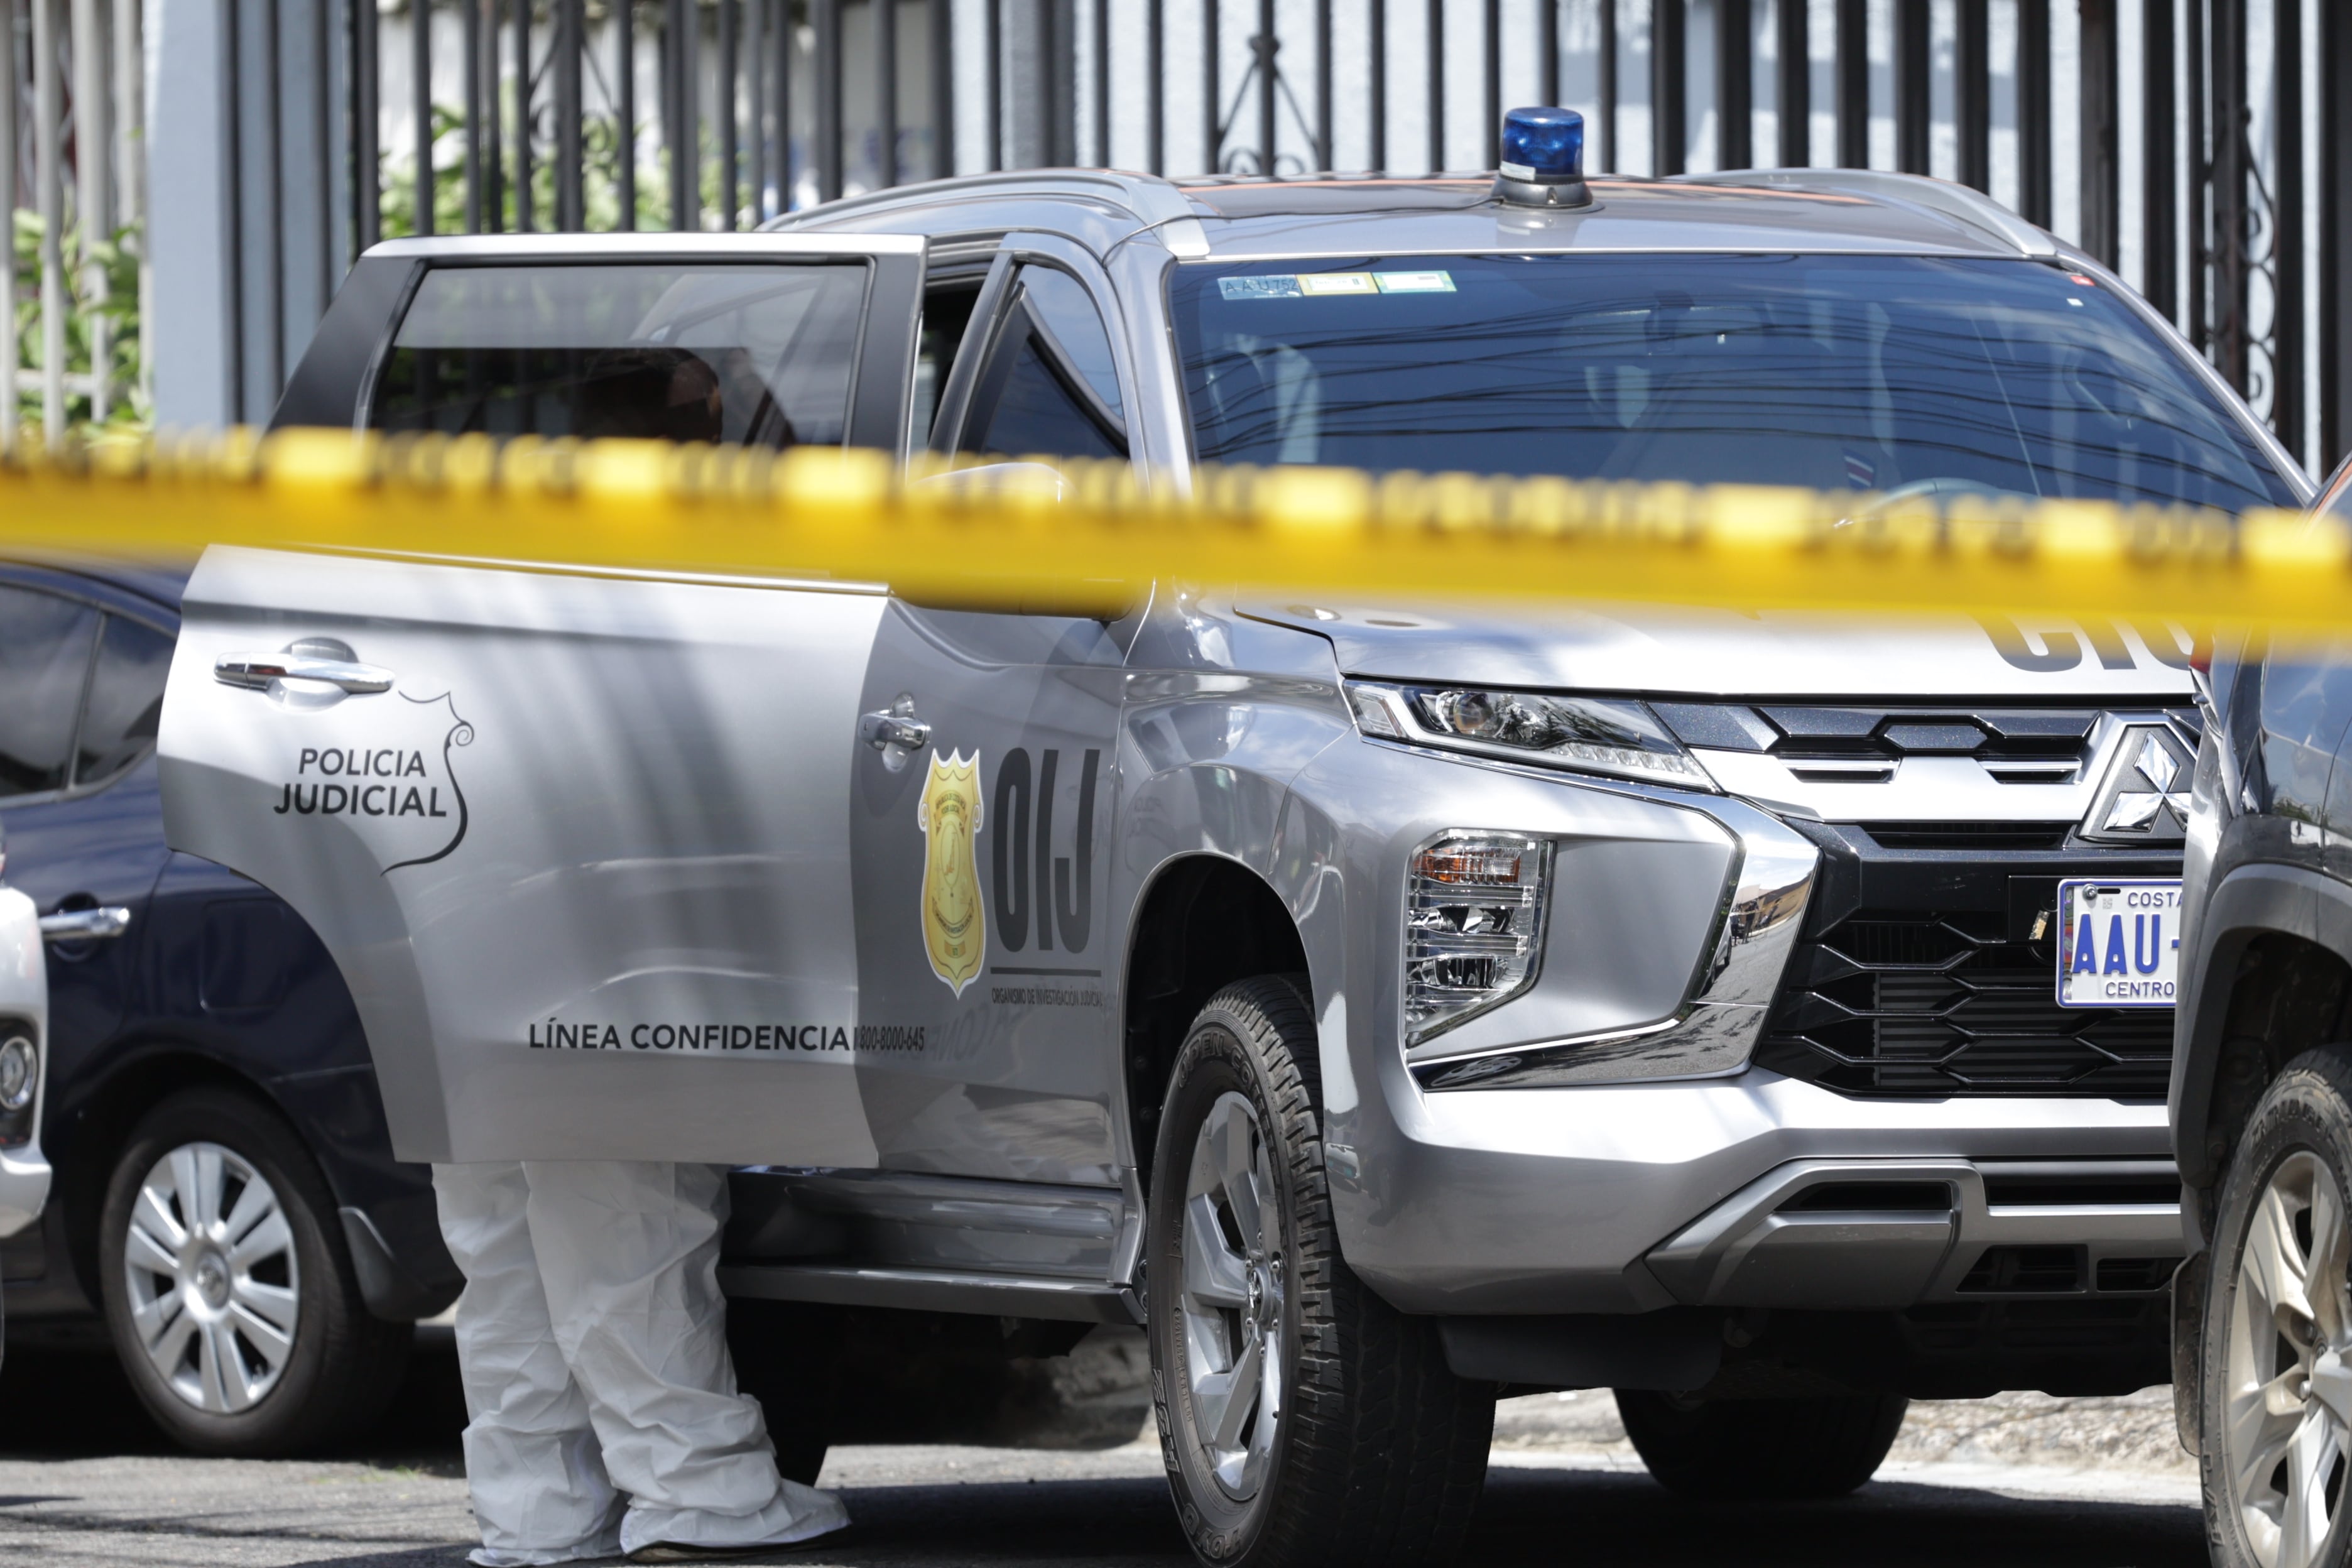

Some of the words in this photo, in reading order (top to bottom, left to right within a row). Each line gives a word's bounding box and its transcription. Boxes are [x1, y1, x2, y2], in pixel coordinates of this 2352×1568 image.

[298, 748, 427, 778] POLICIA
[273, 783, 447, 817] JUDICIAL
[993, 747, 1101, 954] OIJ
[991, 988, 1026, 1004] ORGANISMO
[1027, 988, 1035, 1004] DE
[2106, 981, 2175, 996] CENTRO
[530, 1017, 622, 1049] LÍNEA
[1178, 1031, 1226, 1089] OPEN
[1182, 1502, 1242, 1559] TOYO
